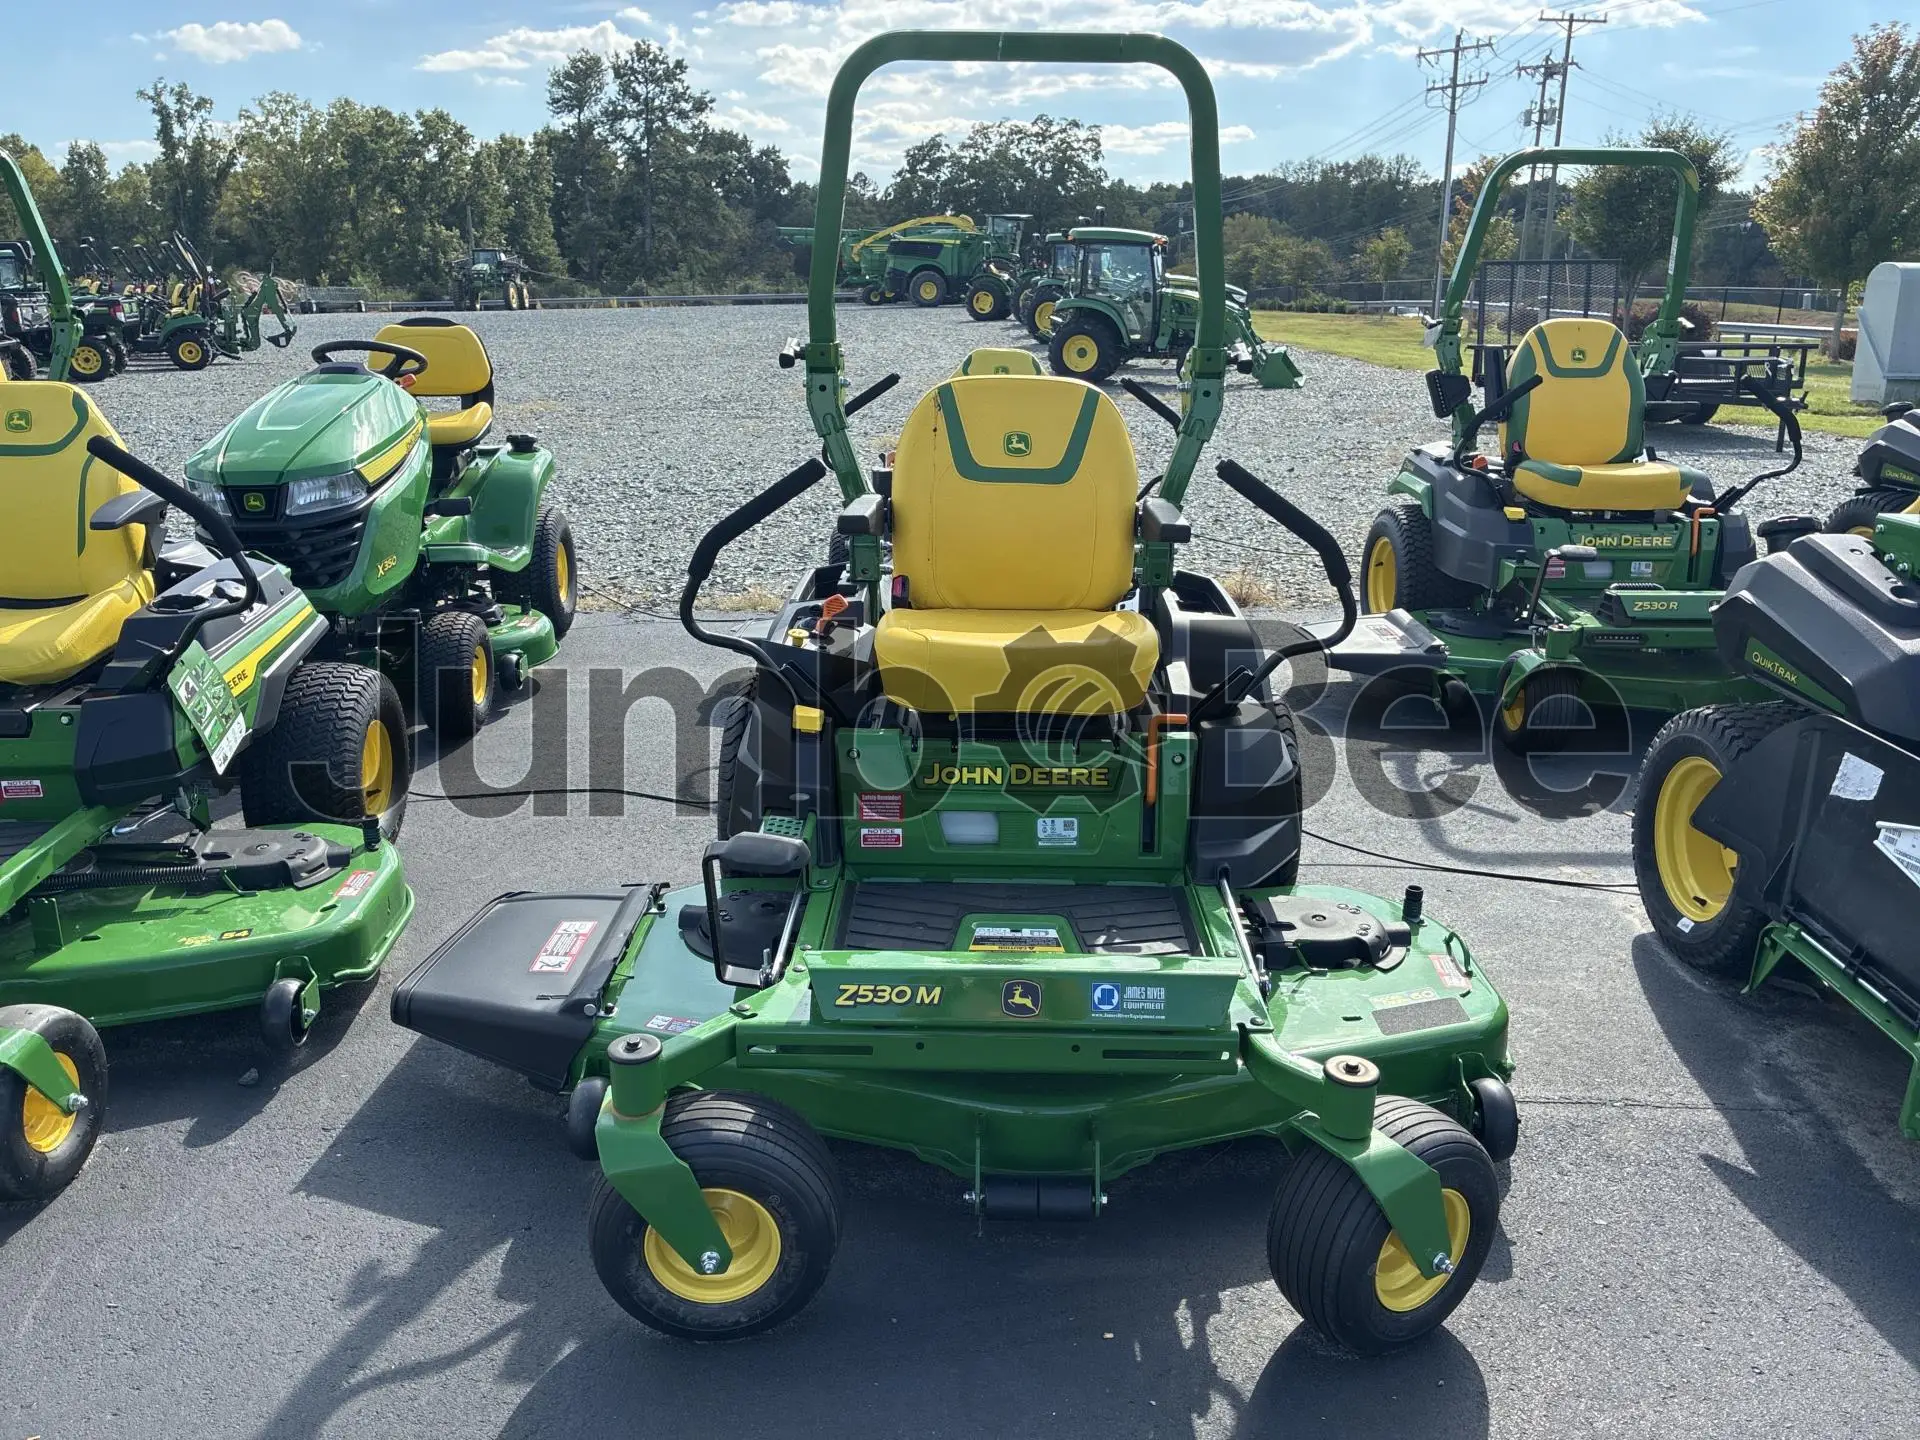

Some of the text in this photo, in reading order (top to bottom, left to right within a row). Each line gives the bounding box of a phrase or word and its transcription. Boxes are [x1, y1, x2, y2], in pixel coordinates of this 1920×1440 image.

[1577, 535, 1673, 547] JOHN DEERE
[377, 555, 396, 578] X350
[1633, 602, 1678, 611] Z530 R
[1752, 651, 1798, 684] QUIKTRAK
[227, 669, 249, 690] EERE
[924, 763, 1109, 785] JOHN DEERE
[835, 984, 942, 1006] Z530 M
[1123, 987, 1165, 999] JAMES RIVER
[1123, 1001, 1165, 1010] EQUIPMENT
